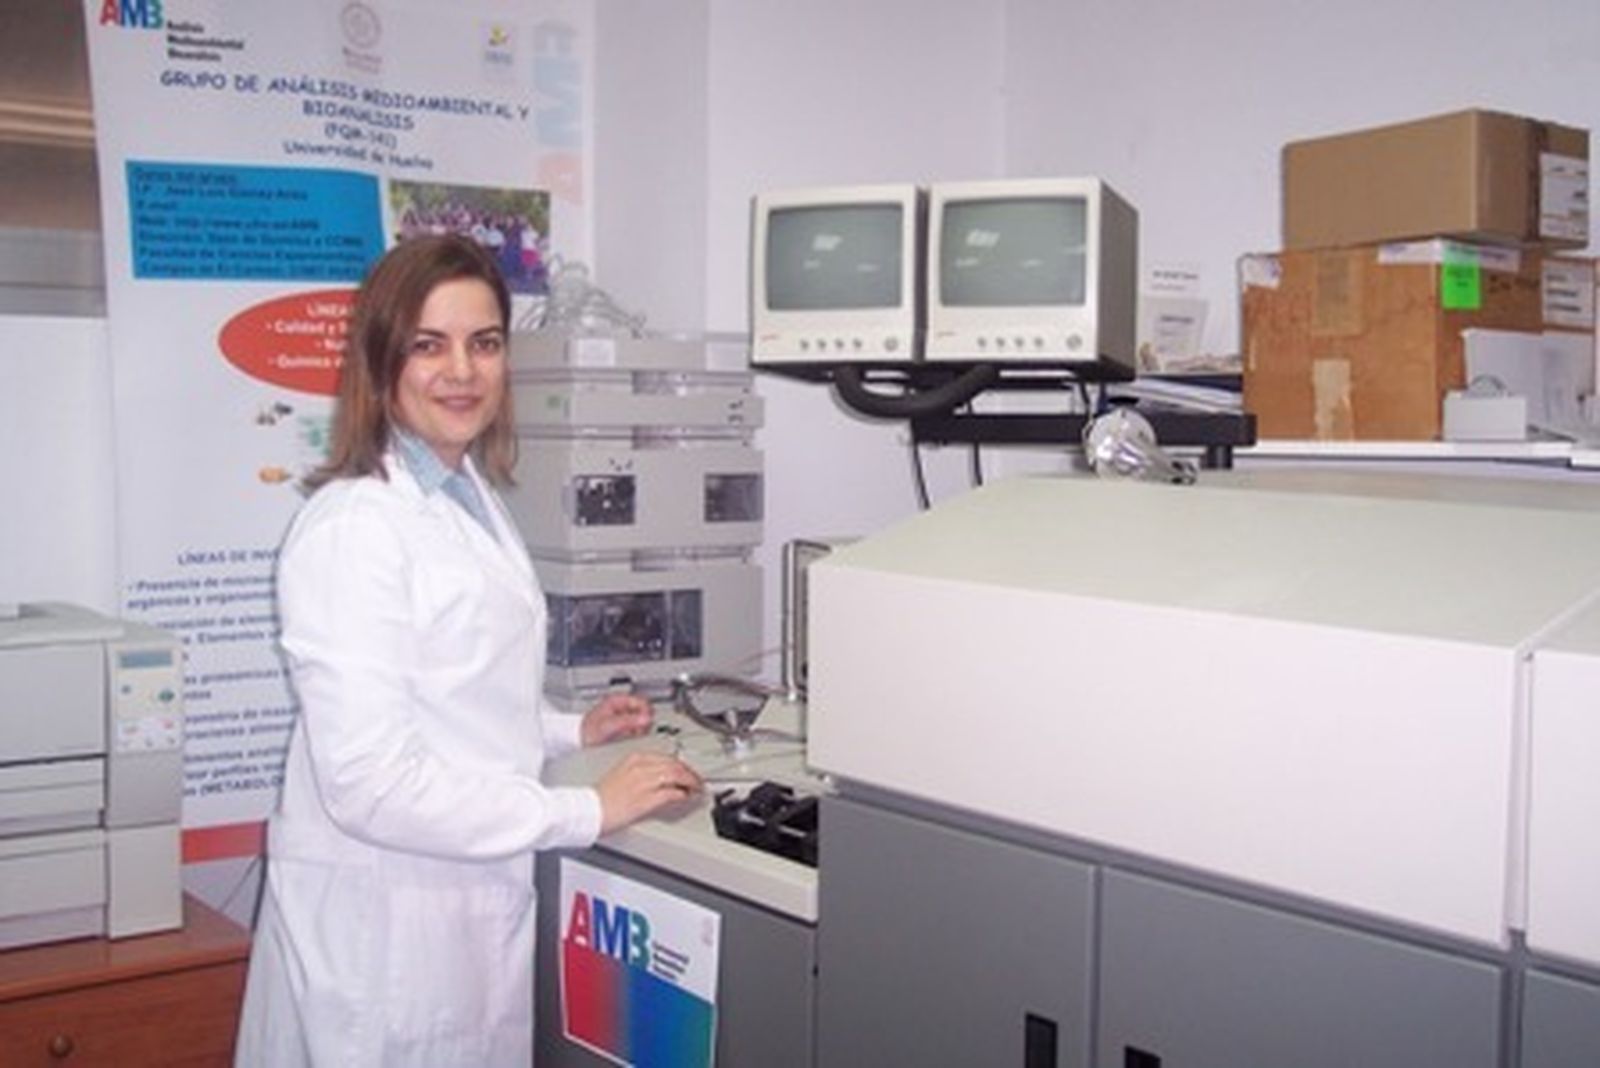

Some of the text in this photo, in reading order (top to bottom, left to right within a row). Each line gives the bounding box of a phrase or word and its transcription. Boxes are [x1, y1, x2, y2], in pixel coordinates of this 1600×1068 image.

[160, 70, 529, 120] GRUPO DE ANÁLISIS MEDIOAMBIENTAL Y
[177, 552, 226, 567] LÍNEAS
[230, 550, 247, 563] DE
[563, 889, 650, 969] AMB
